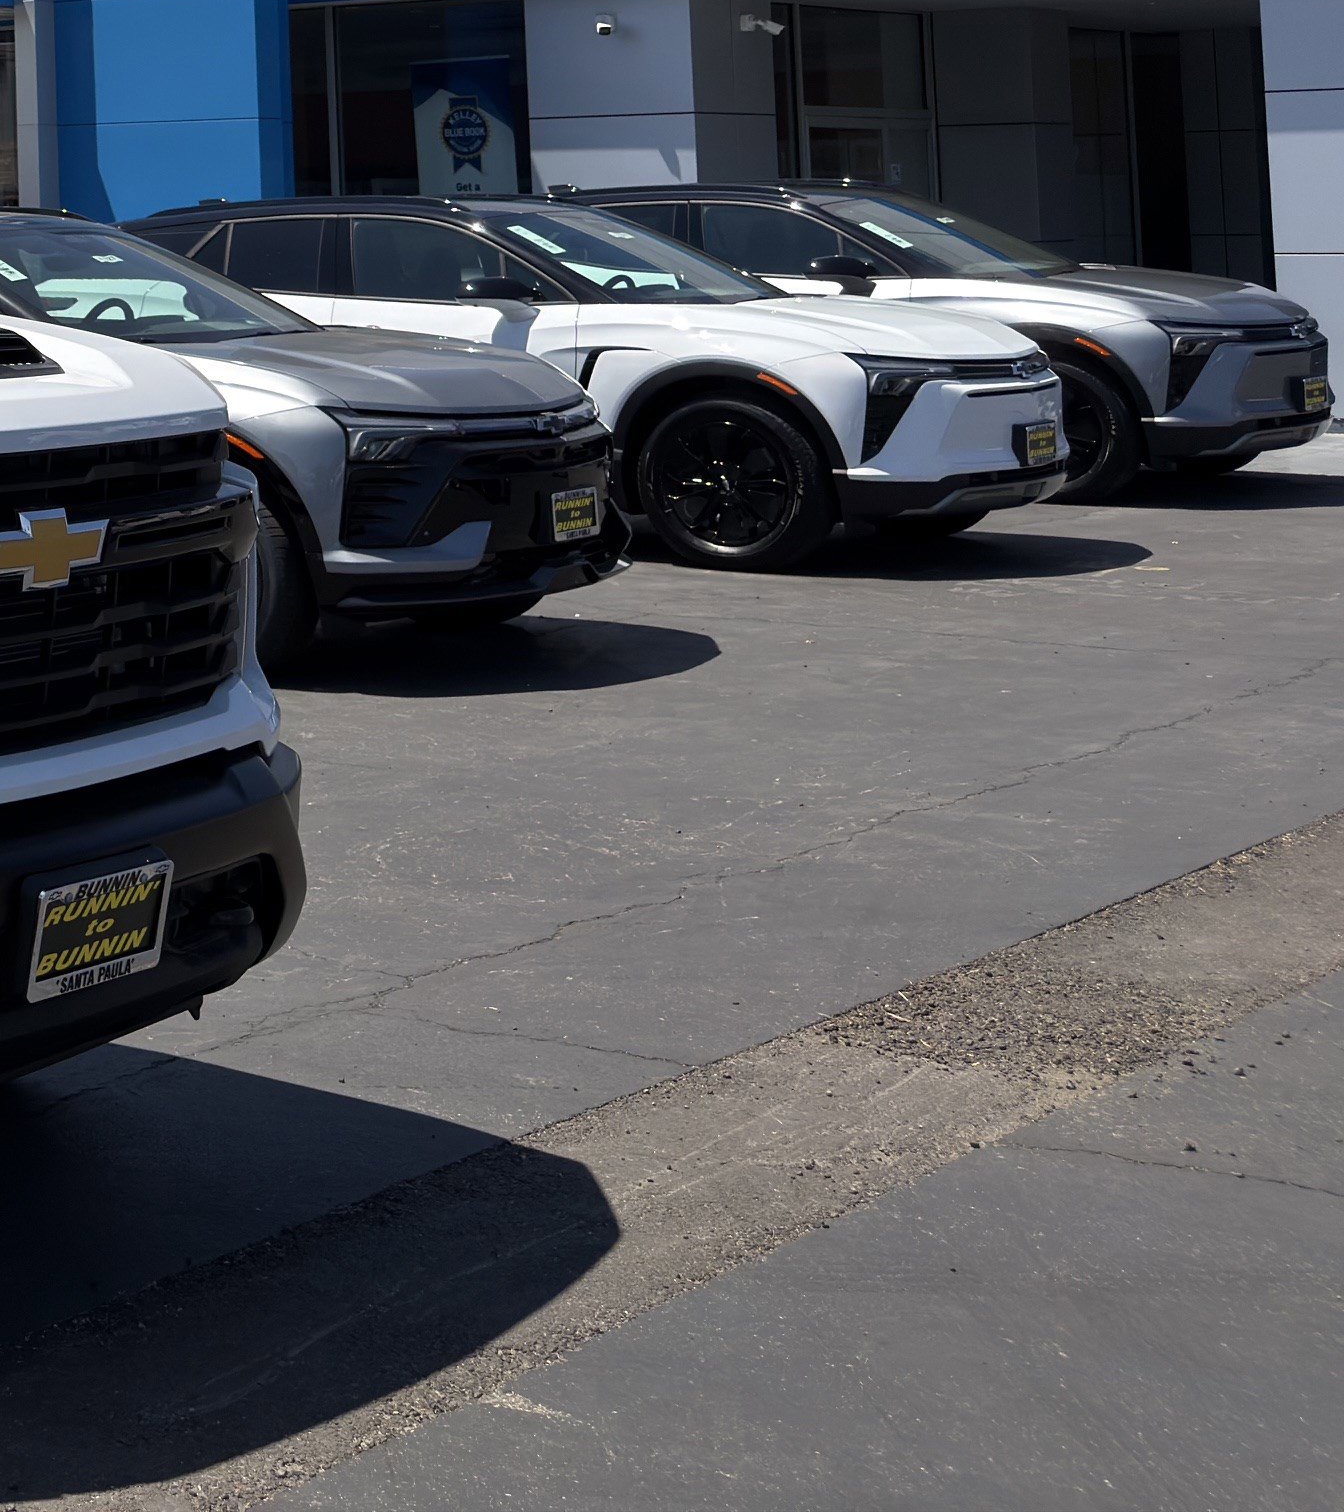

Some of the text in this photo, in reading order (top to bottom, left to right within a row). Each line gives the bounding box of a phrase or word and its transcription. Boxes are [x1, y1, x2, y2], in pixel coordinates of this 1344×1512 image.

[443, 127, 486, 138] BLUE BOOK
[456, 182, 472, 191] Get
[74, 870, 141, 899] BUNNIN
[43, 880, 161, 928] RUNNIN'
[85, 918, 115, 937] to
[36, 926, 148, 977] BUNNIN
